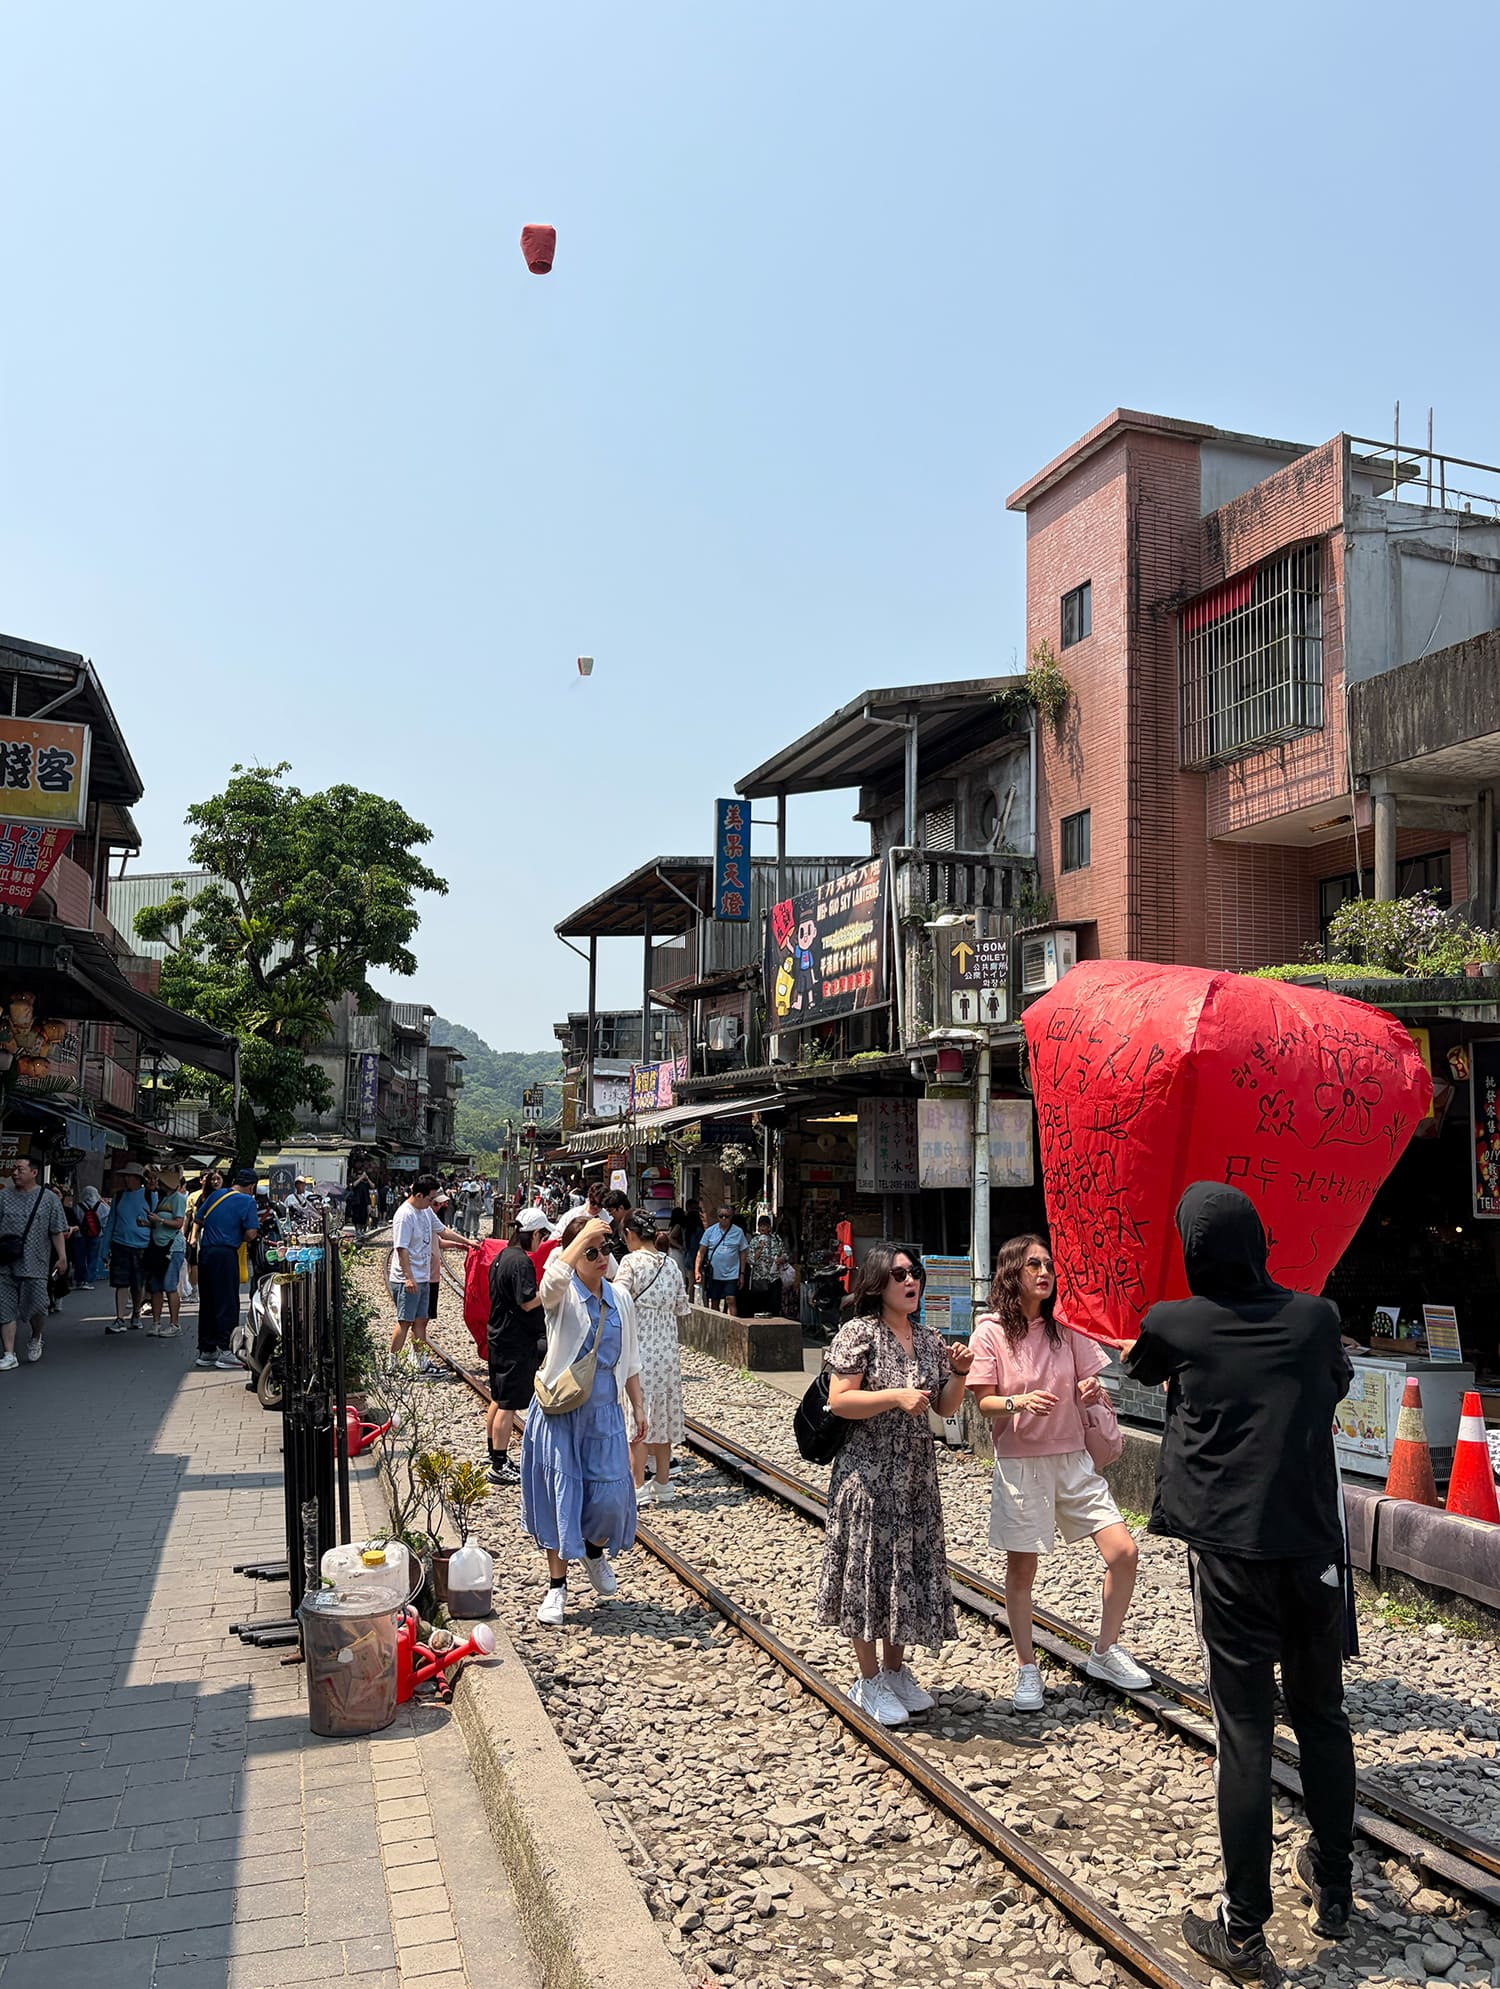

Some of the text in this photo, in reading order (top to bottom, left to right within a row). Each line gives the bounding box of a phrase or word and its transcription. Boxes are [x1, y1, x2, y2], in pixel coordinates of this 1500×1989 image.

[722, 804, 745, 916] 美果天燈
[975, 942, 1007, 953] 160M
[974, 953, 1006, 963] TOILET
